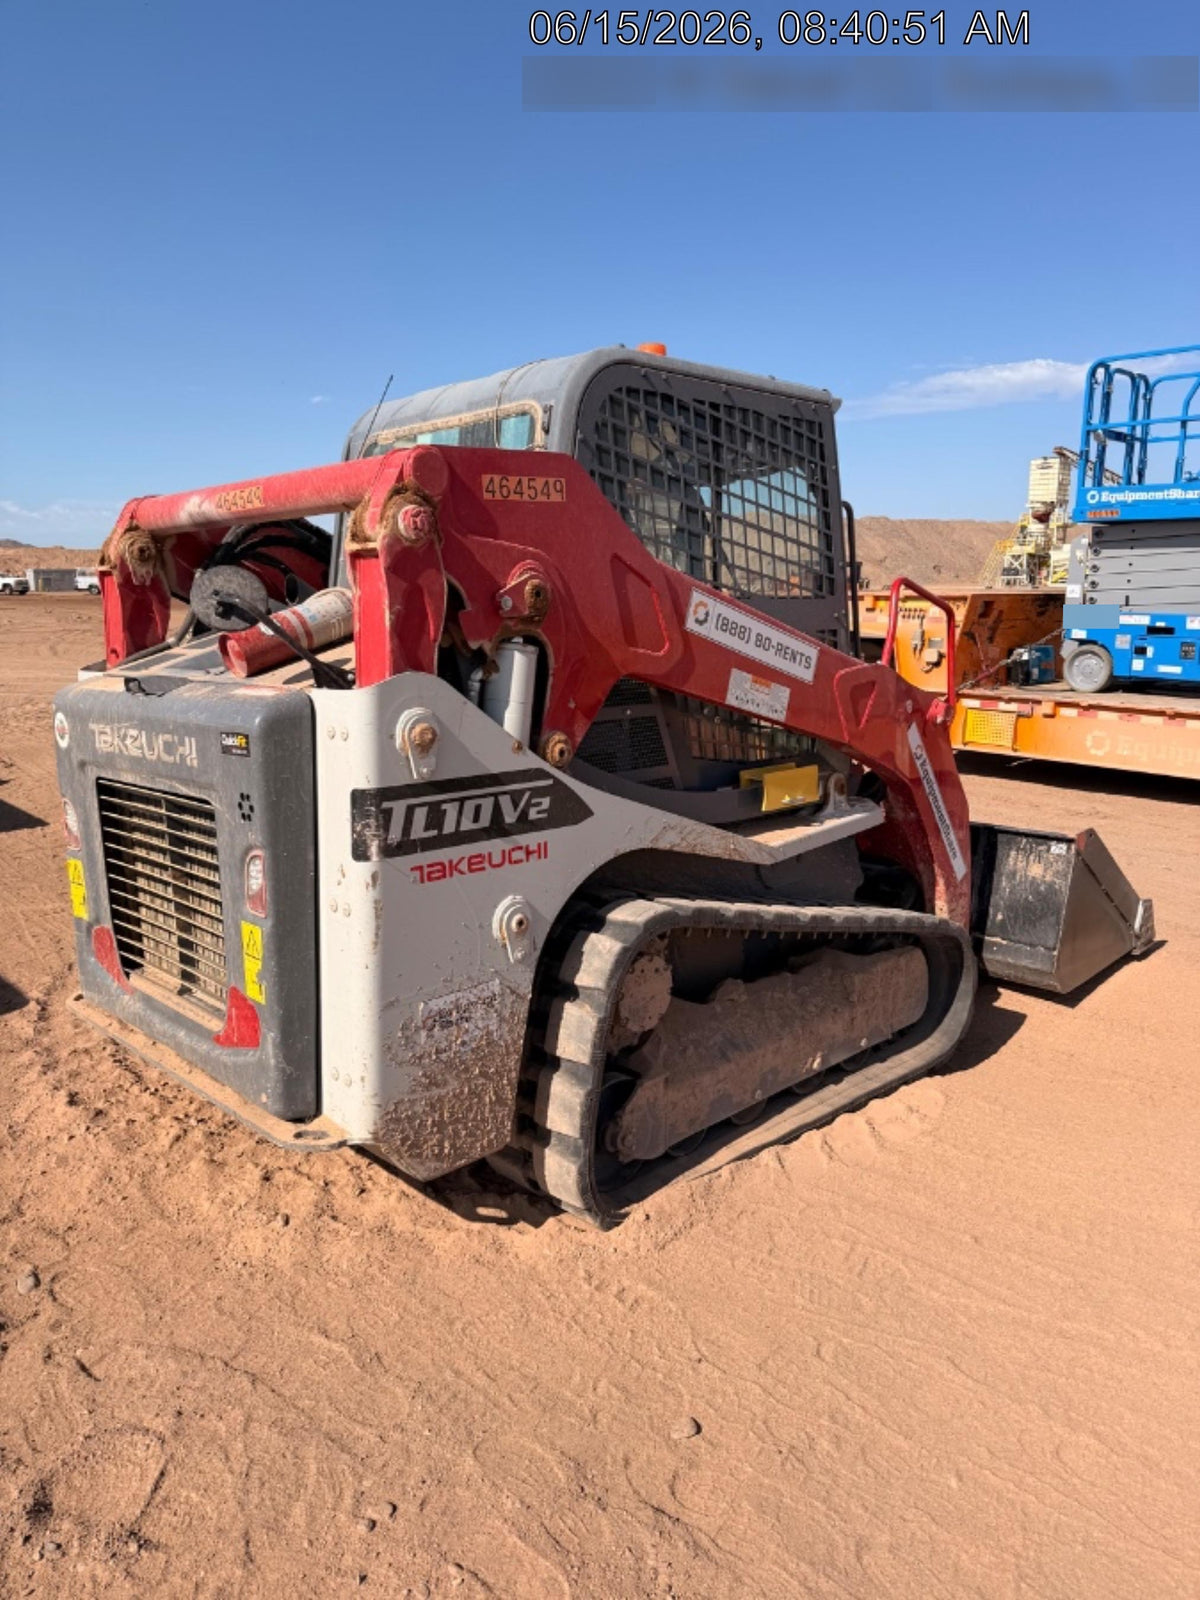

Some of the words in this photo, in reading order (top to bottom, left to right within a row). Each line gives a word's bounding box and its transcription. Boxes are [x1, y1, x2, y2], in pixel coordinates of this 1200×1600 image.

[215, 486, 262, 511] 464549
[484, 476, 564, 500] 464549
[714, 613, 752, 645] (888)
[754, 632, 812, 670] 80-RENTS
